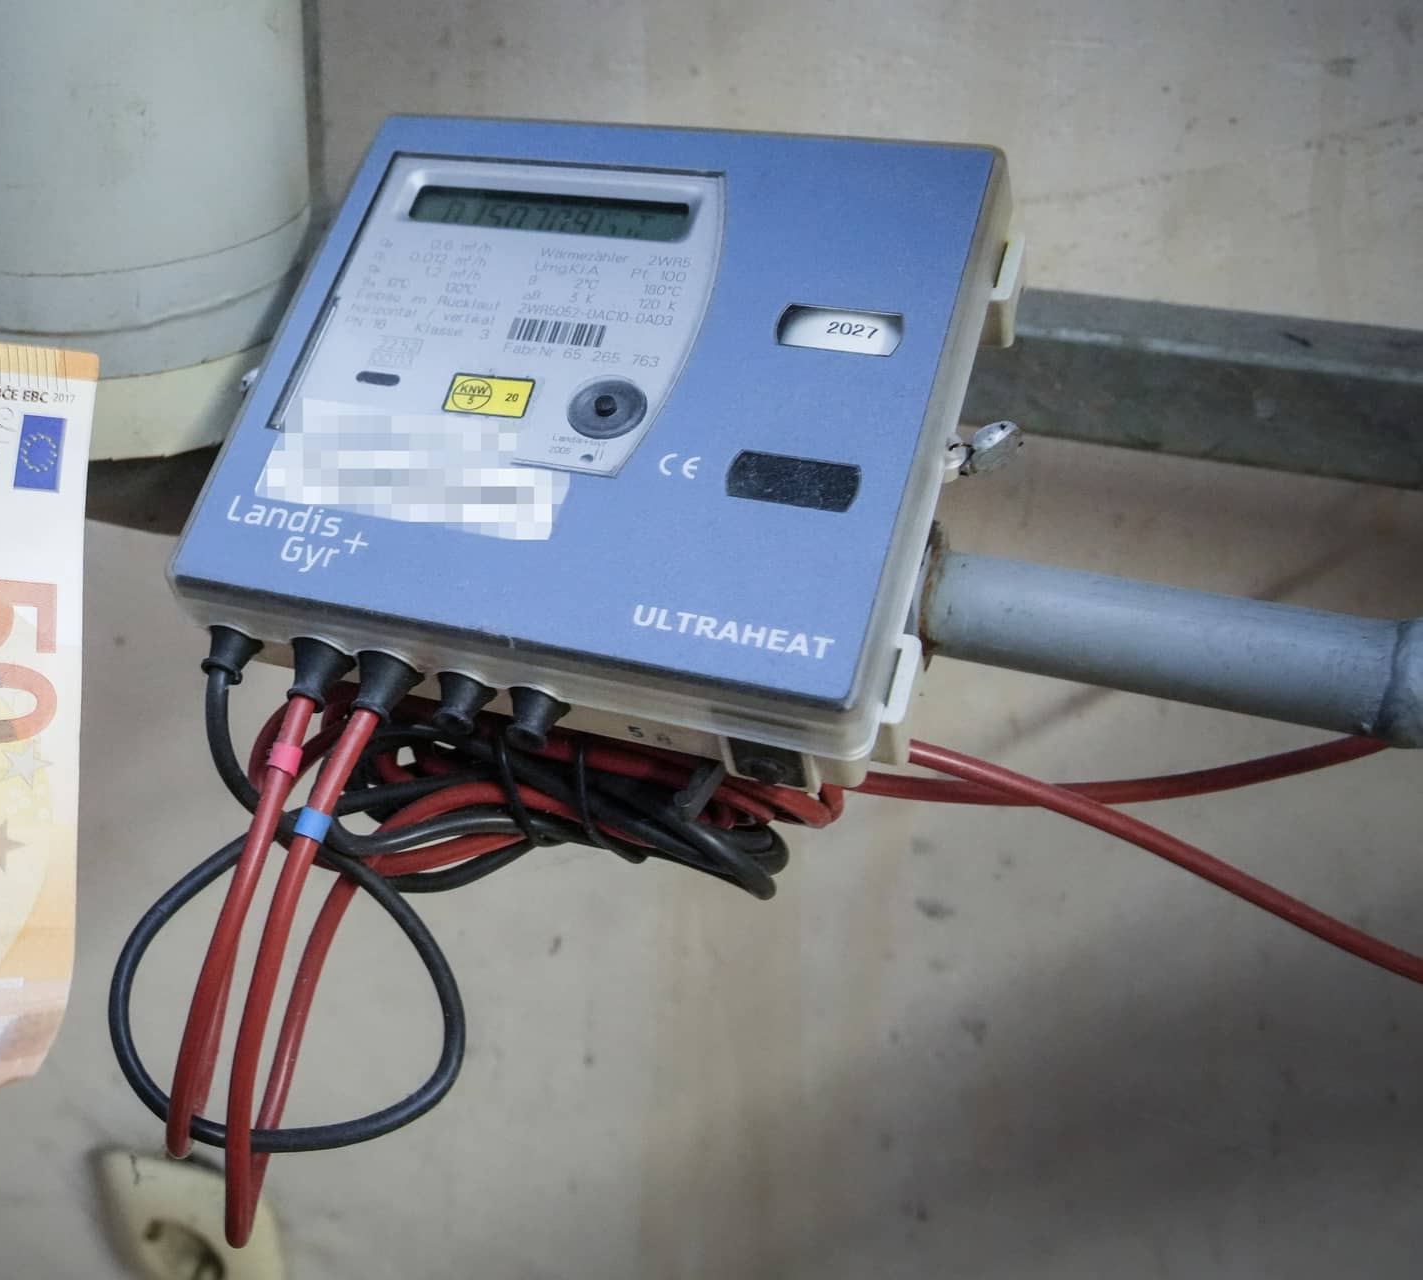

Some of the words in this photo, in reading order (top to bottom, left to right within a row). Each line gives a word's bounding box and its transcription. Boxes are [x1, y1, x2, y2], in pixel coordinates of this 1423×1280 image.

[662, 271, 687, 282] 100
[826, 320, 880, 340] 2027
[632, 354, 661, 368] 763
[22, 390, 49, 404] EBC
[52, 392, 76, 405] 2017
[459, 384, 489, 396] KNW
[505, 392, 519, 403] 20
[658, 453, 702, 480] CE
[227, 495, 343, 538] Landis
[280, 536, 340, 573] Gyr
[633, 604, 835, 660] ULTRAHEAT
